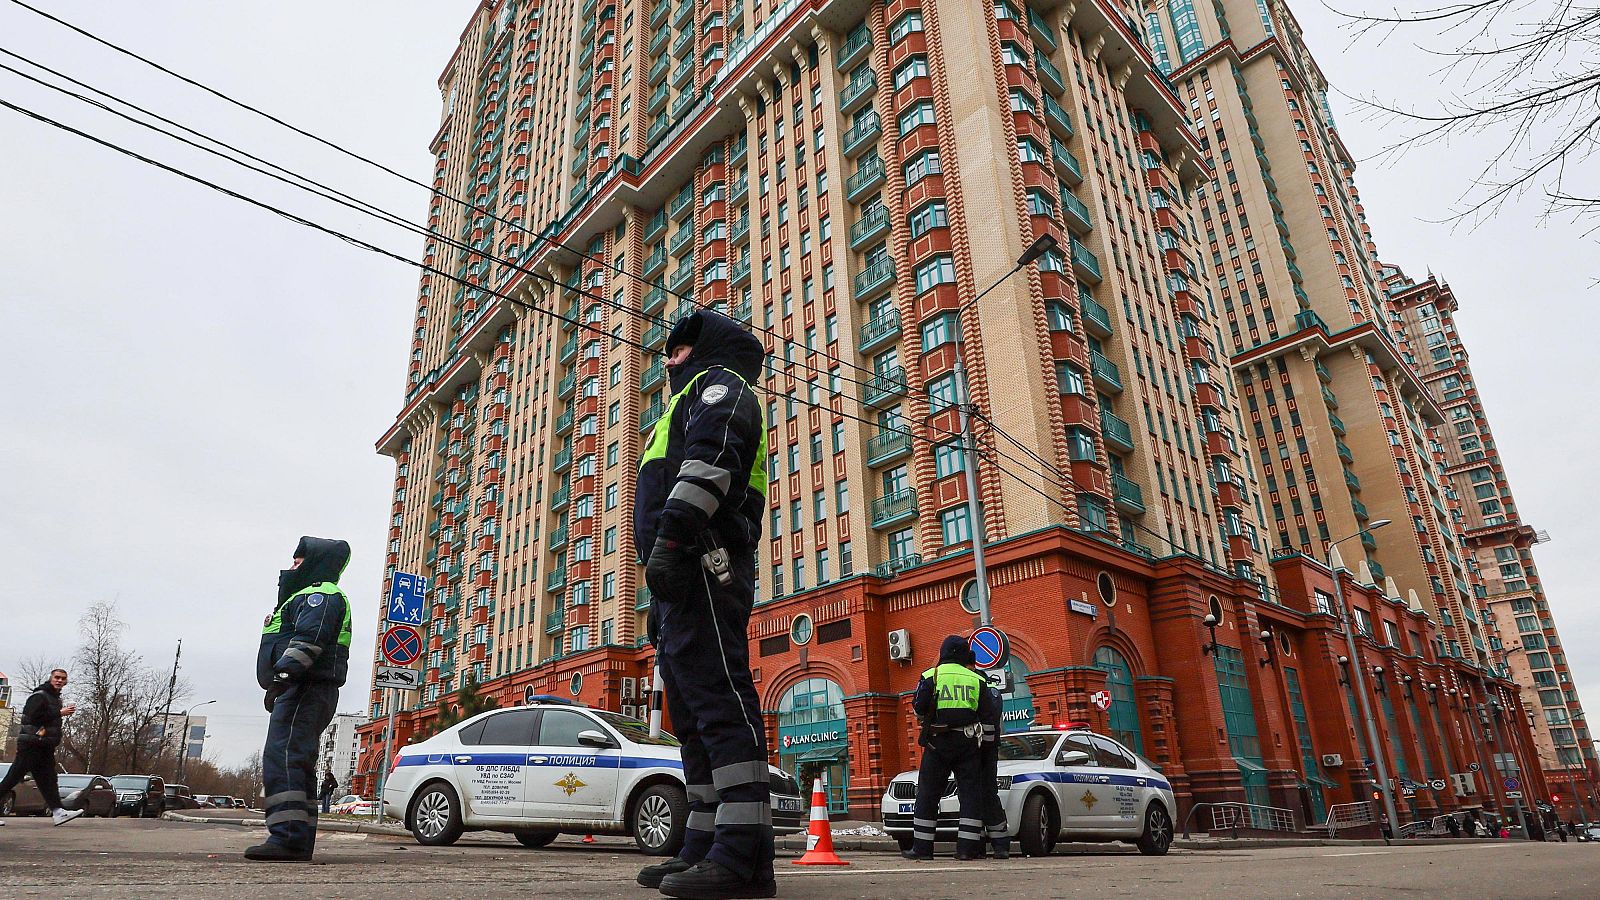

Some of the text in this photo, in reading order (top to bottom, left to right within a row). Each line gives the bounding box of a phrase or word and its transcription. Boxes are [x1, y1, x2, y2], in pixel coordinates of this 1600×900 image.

[940, 684, 976, 703] ДПС
[1002, 709, 1030, 722] ИНИК
[791, 731, 838, 745] ALAN CLINIC
[548, 755, 597, 767] ПОЛИЦИЯ
[486, 765, 499, 773] ДПС
[500, 765, 520, 773] ГИБДД
